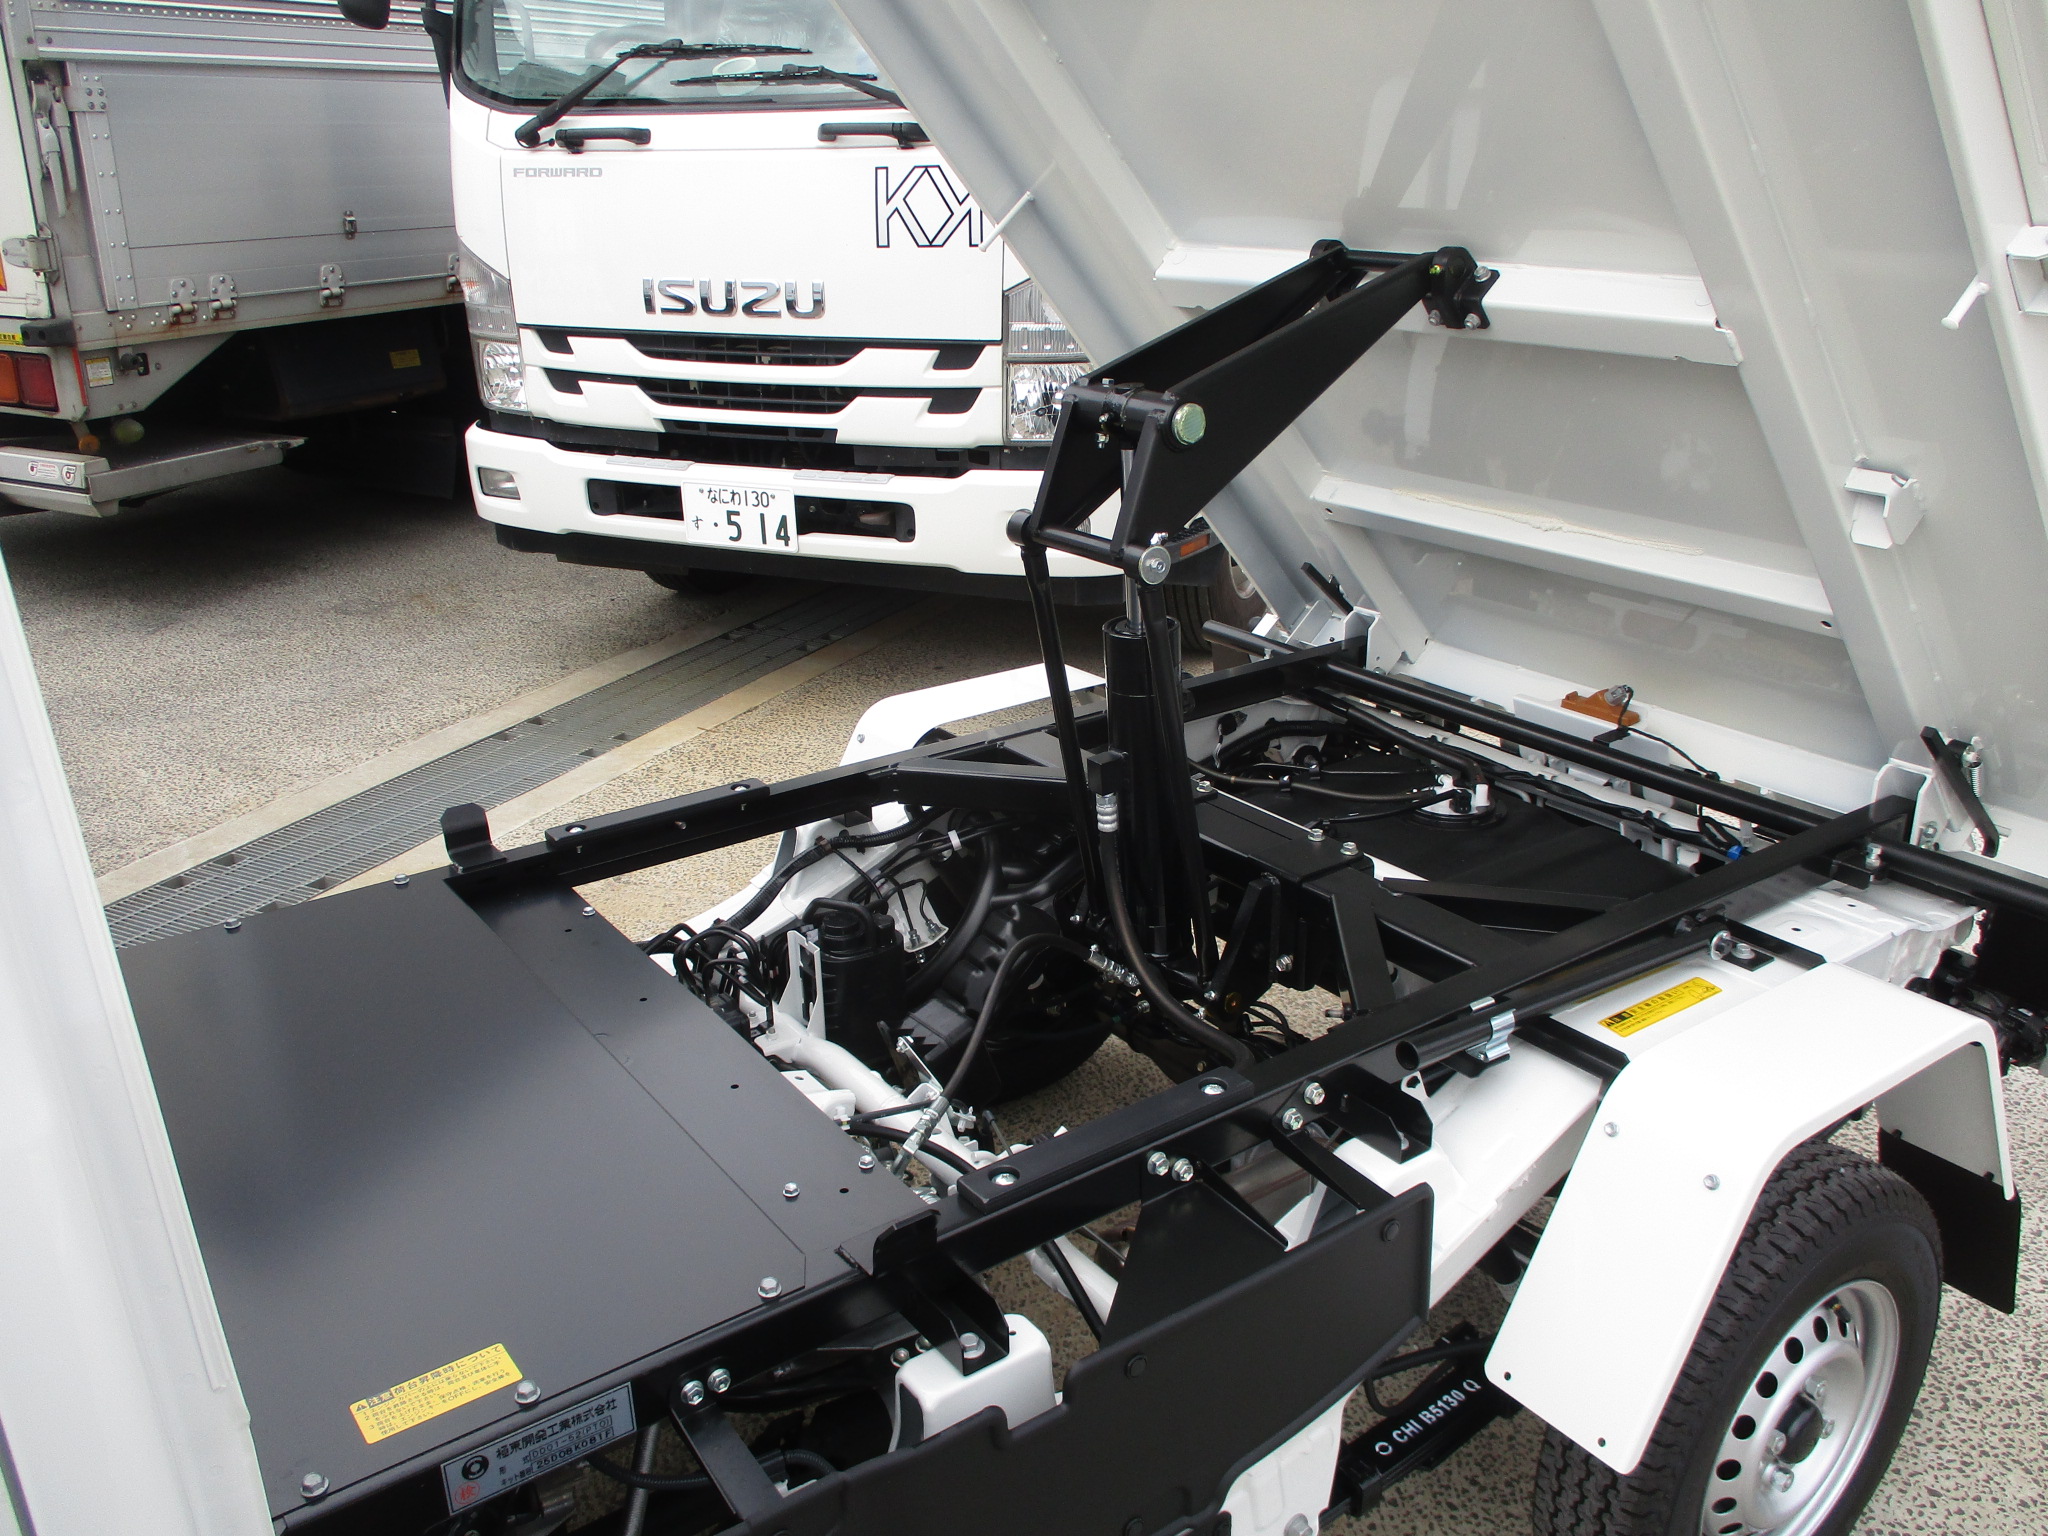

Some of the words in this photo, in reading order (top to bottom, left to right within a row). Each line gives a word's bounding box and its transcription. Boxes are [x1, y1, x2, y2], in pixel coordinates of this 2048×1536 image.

[512, 167, 603, 178] FORWARD
[642, 277, 826, 319] ISUZU
[692, 516, 703, 530] す
[367, 1391, 393, 1406] 注意
[393, 1344, 502, 1395] 荷台昇降時について
[1392, 1419, 1423, 1443] CHI
[1418, 1389, 1466, 1425] B5130
